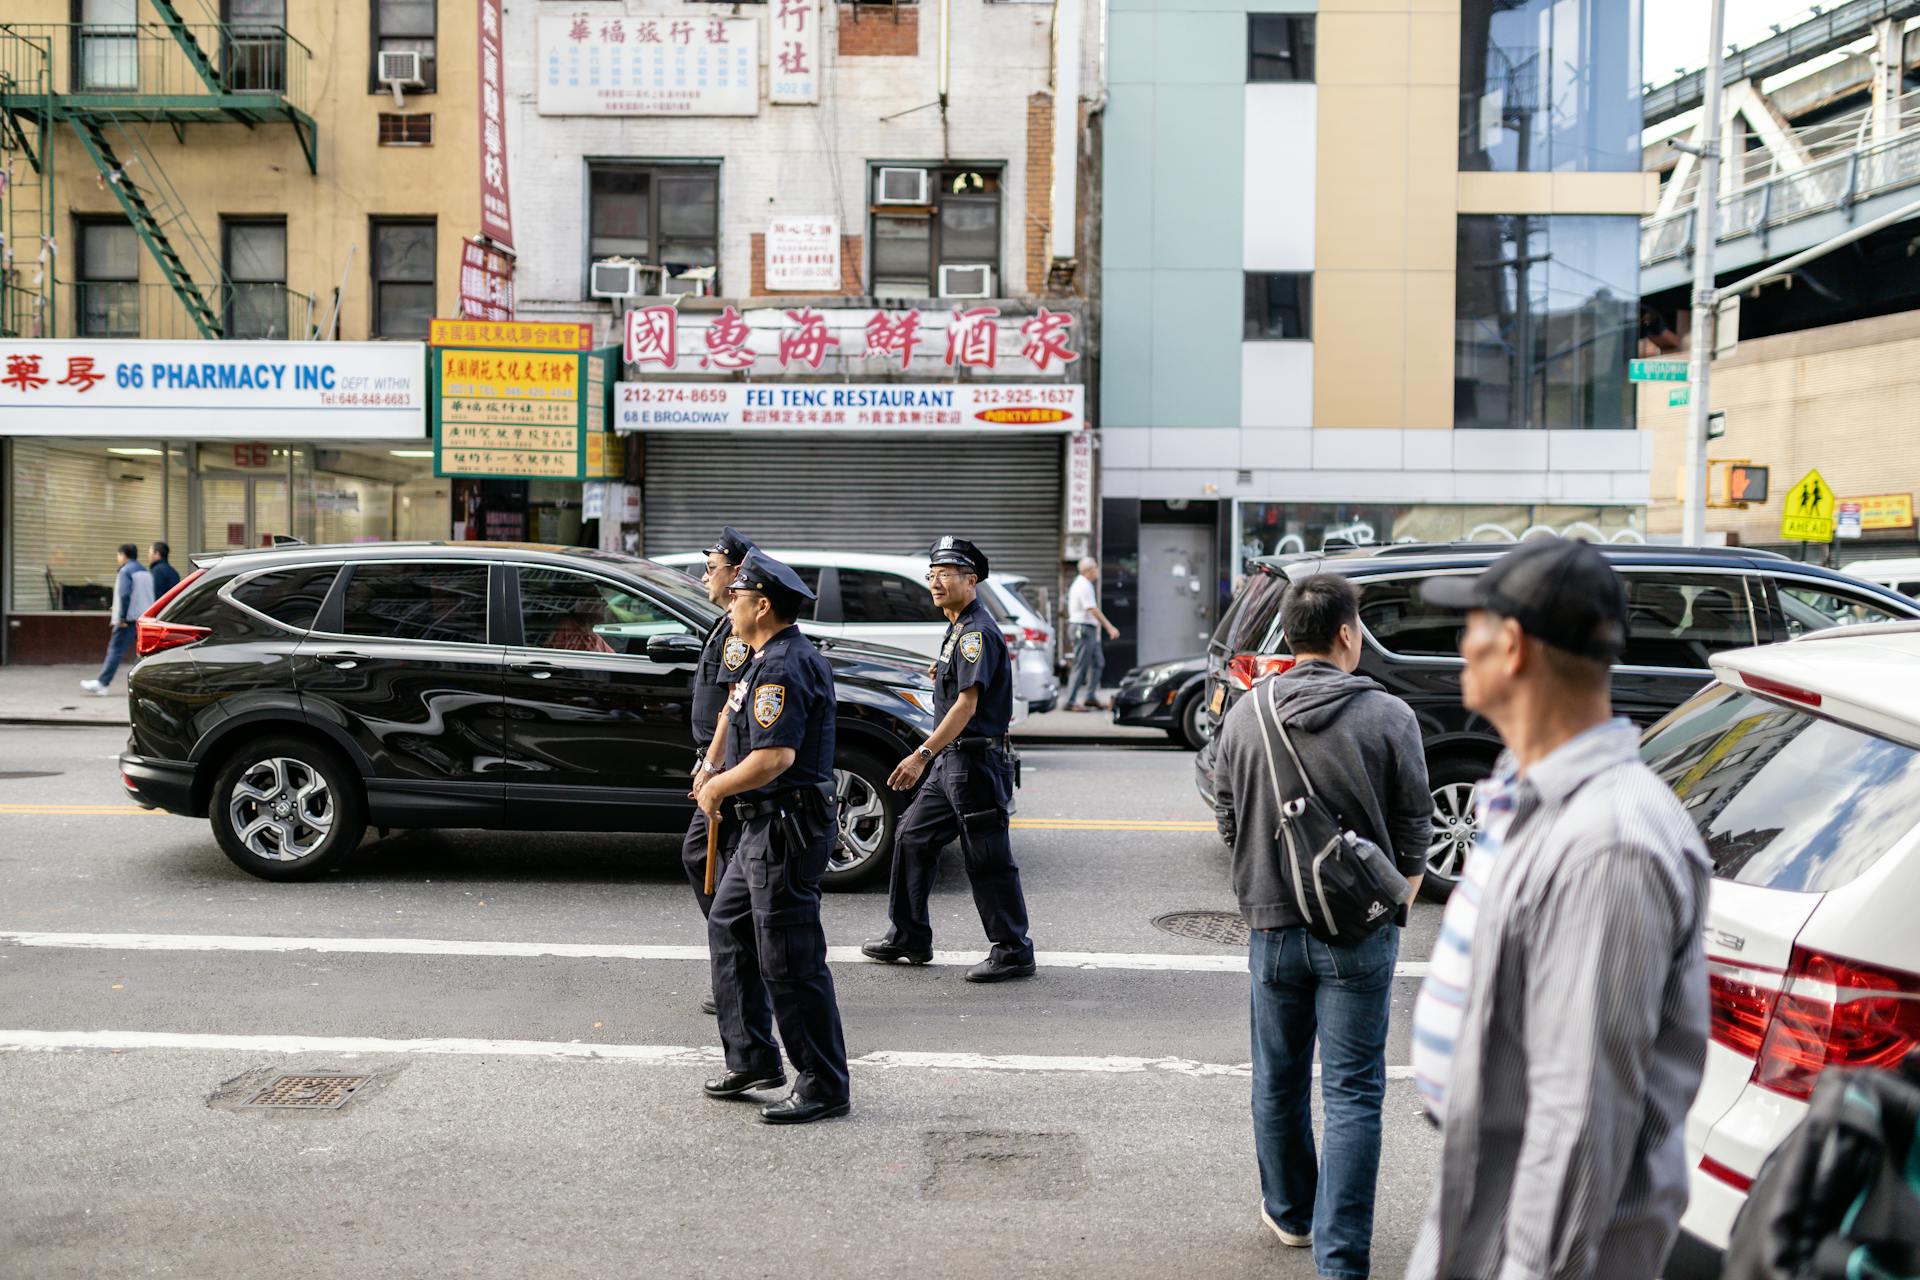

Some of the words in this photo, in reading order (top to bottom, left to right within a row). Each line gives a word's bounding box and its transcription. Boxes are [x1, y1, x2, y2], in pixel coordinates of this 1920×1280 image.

[568, 19, 730, 44] 華福旅行社
[0, 354, 106, 393] 藥房
[116, 363, 144, 389] 66
[152, 364, 287, 390] PHARMACY
[295, 364, 336, 390] INC
[374, 376, 411, 390] WITHIN
[624, 388, 727, 402] 212-274-8659
[747, 390, 773, 406] FEI
[833, 390, 954, 406] RESTAURANT
[973, 389, 1075, 404] 212-925-1637
[624, 411, 638, 422] 68
[643, 411, 649, 423] E
[654, 411, 729, 423] BROADWAY
[1788, 521, 1828, 535] AHEAD
